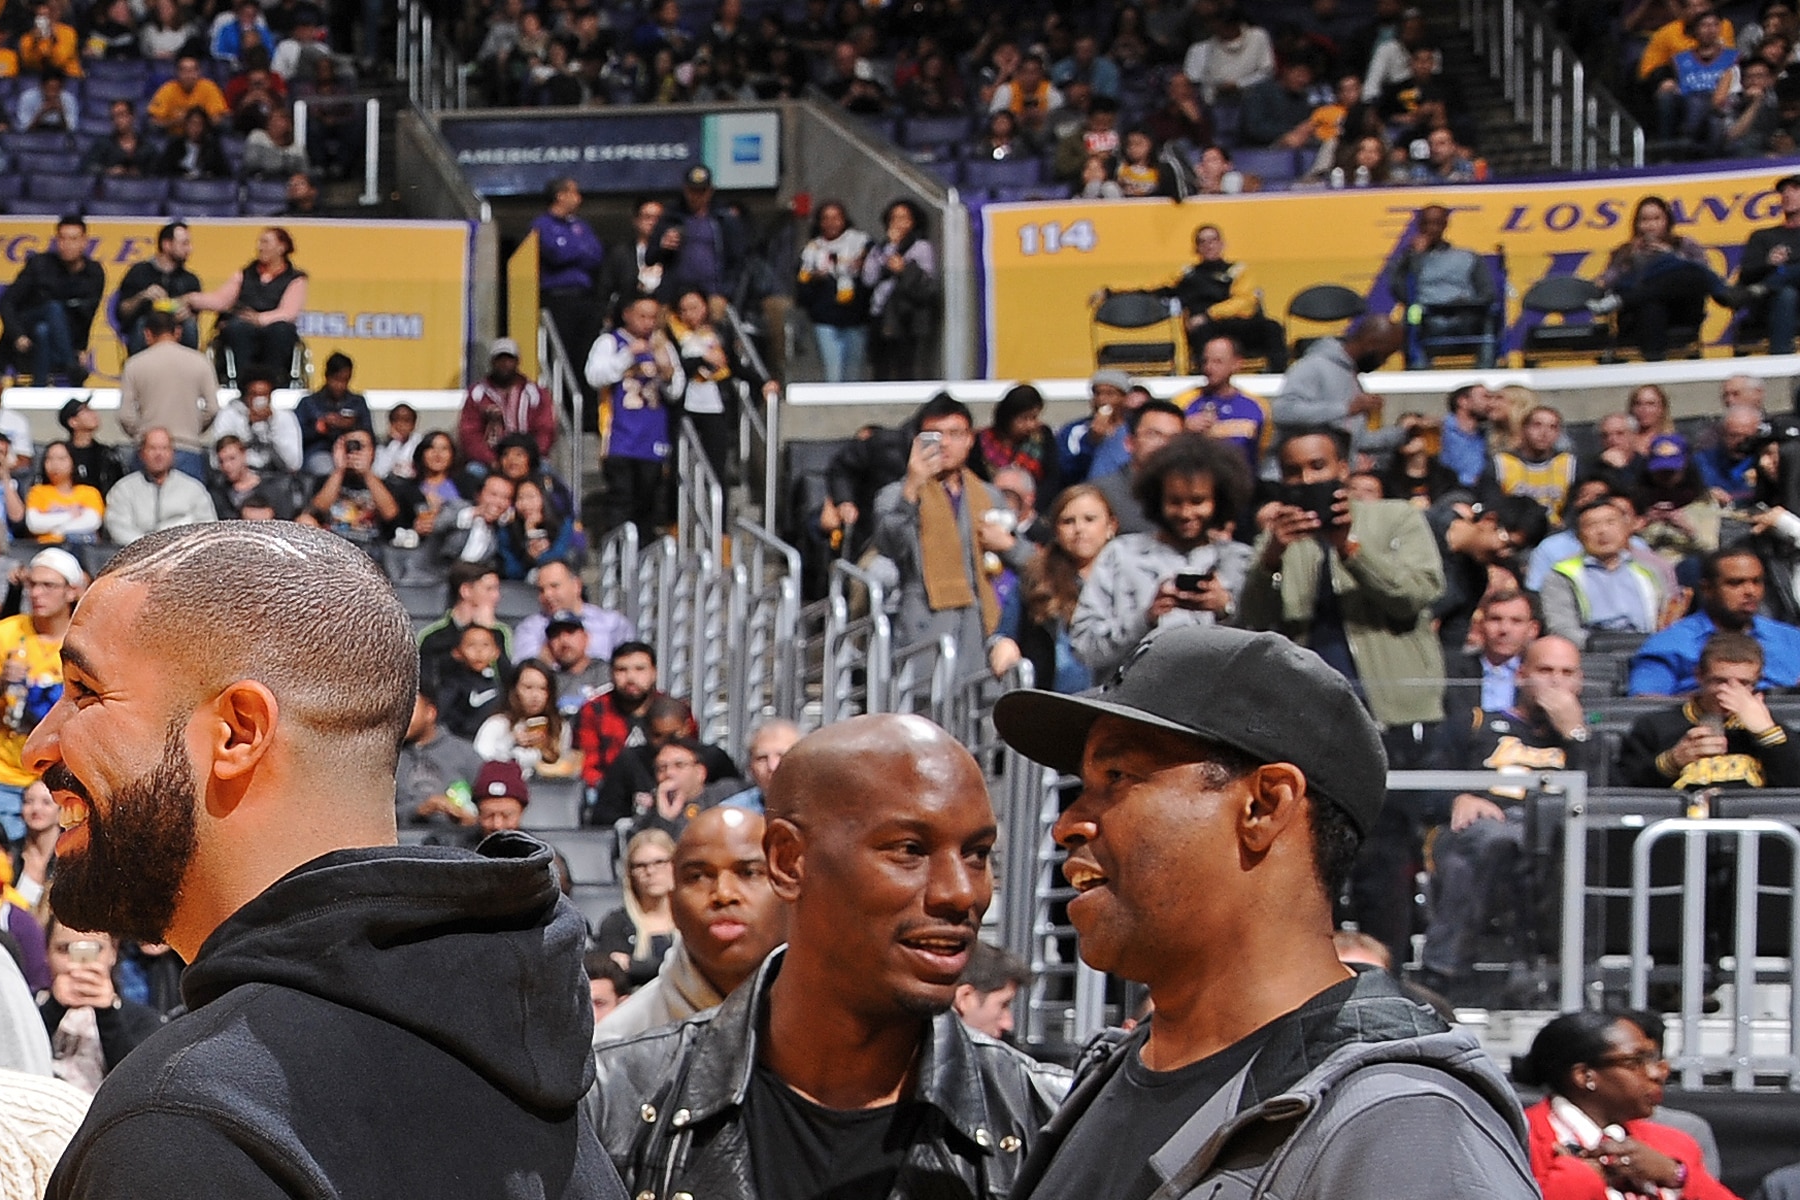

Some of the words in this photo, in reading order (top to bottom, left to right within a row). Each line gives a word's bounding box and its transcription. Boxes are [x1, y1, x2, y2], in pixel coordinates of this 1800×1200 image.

[457, 147, 580, 165] AMERICAN
[583, 143, 690, 161] EXPRESS
[1501, 199, 1624, 232] LOS
[1019, 219, 1097, 256] 114
